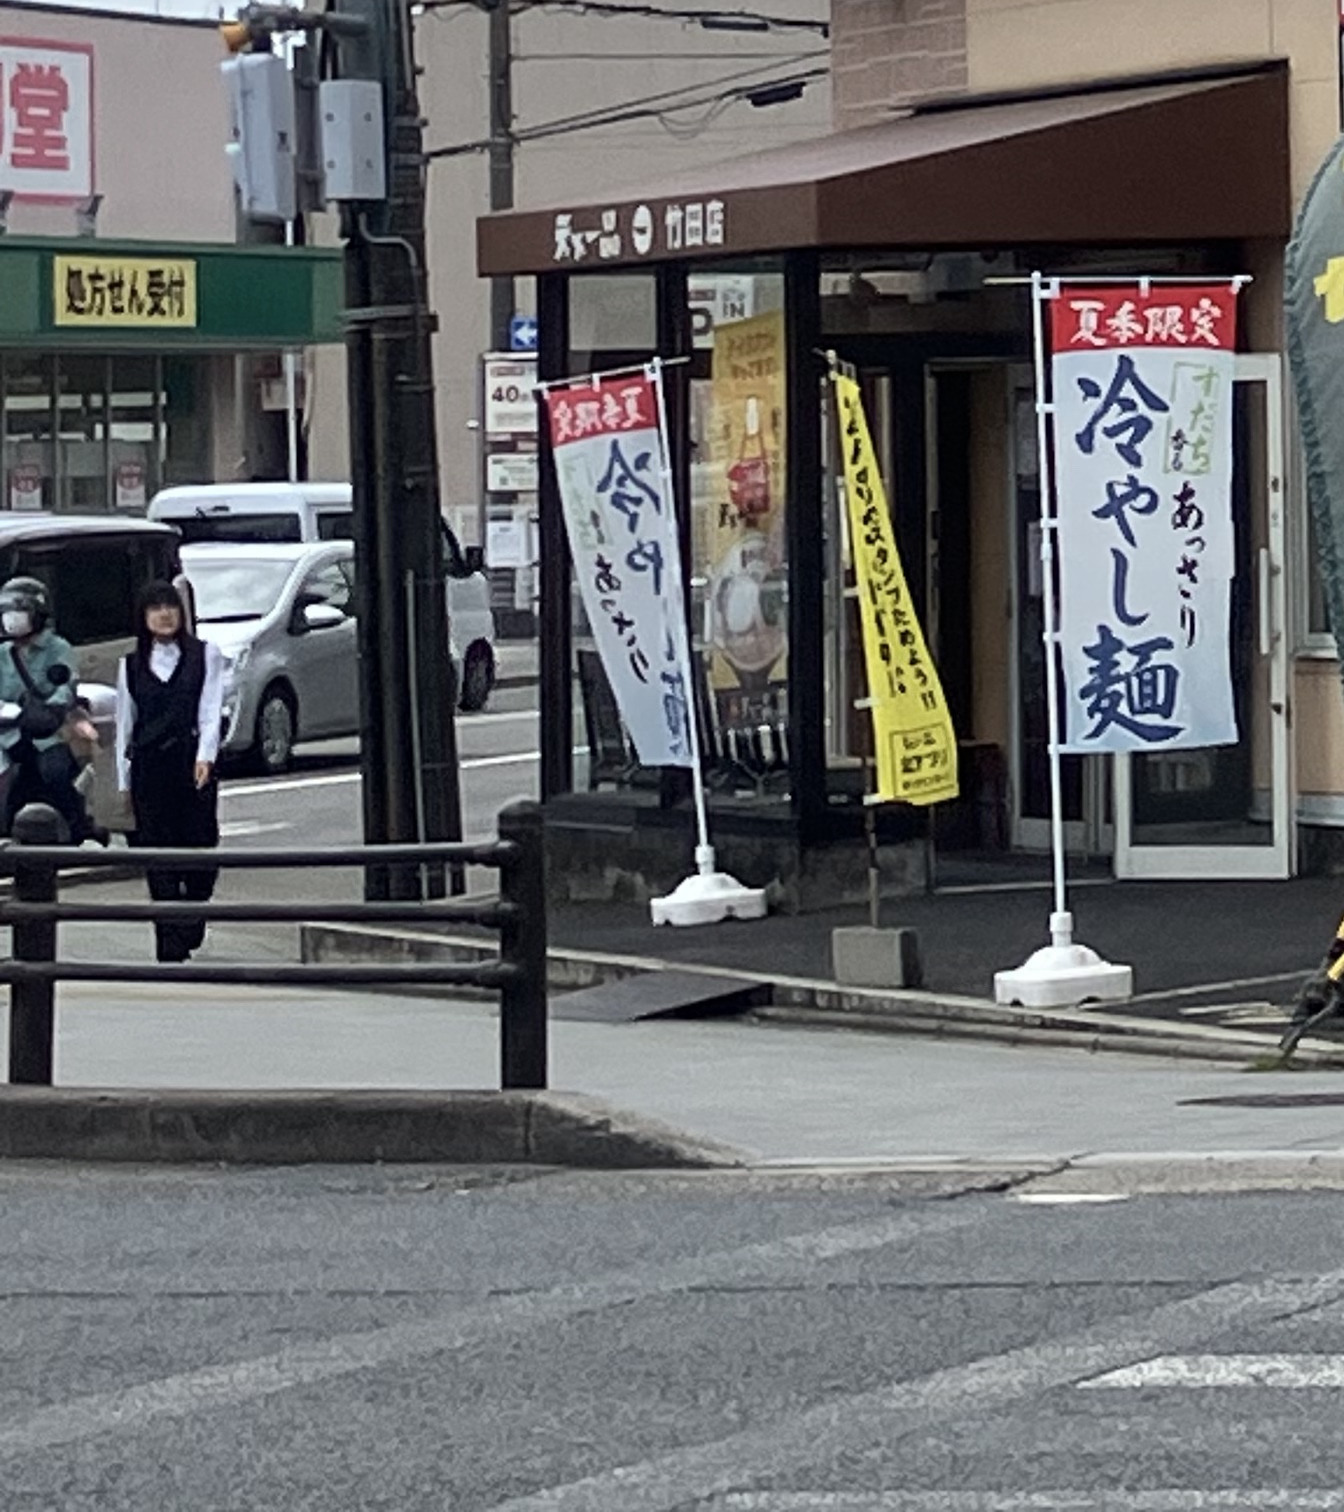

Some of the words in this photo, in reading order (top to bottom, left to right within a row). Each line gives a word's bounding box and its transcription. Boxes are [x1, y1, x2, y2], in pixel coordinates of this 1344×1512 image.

[65, 263, 187, 318] 処方せん受付
[1069, 297, 1223, 347] 夏季限定
[1074, 353, 1187, 744] 冷やし麺
[1171, 481, 1206, 649] あっさり
